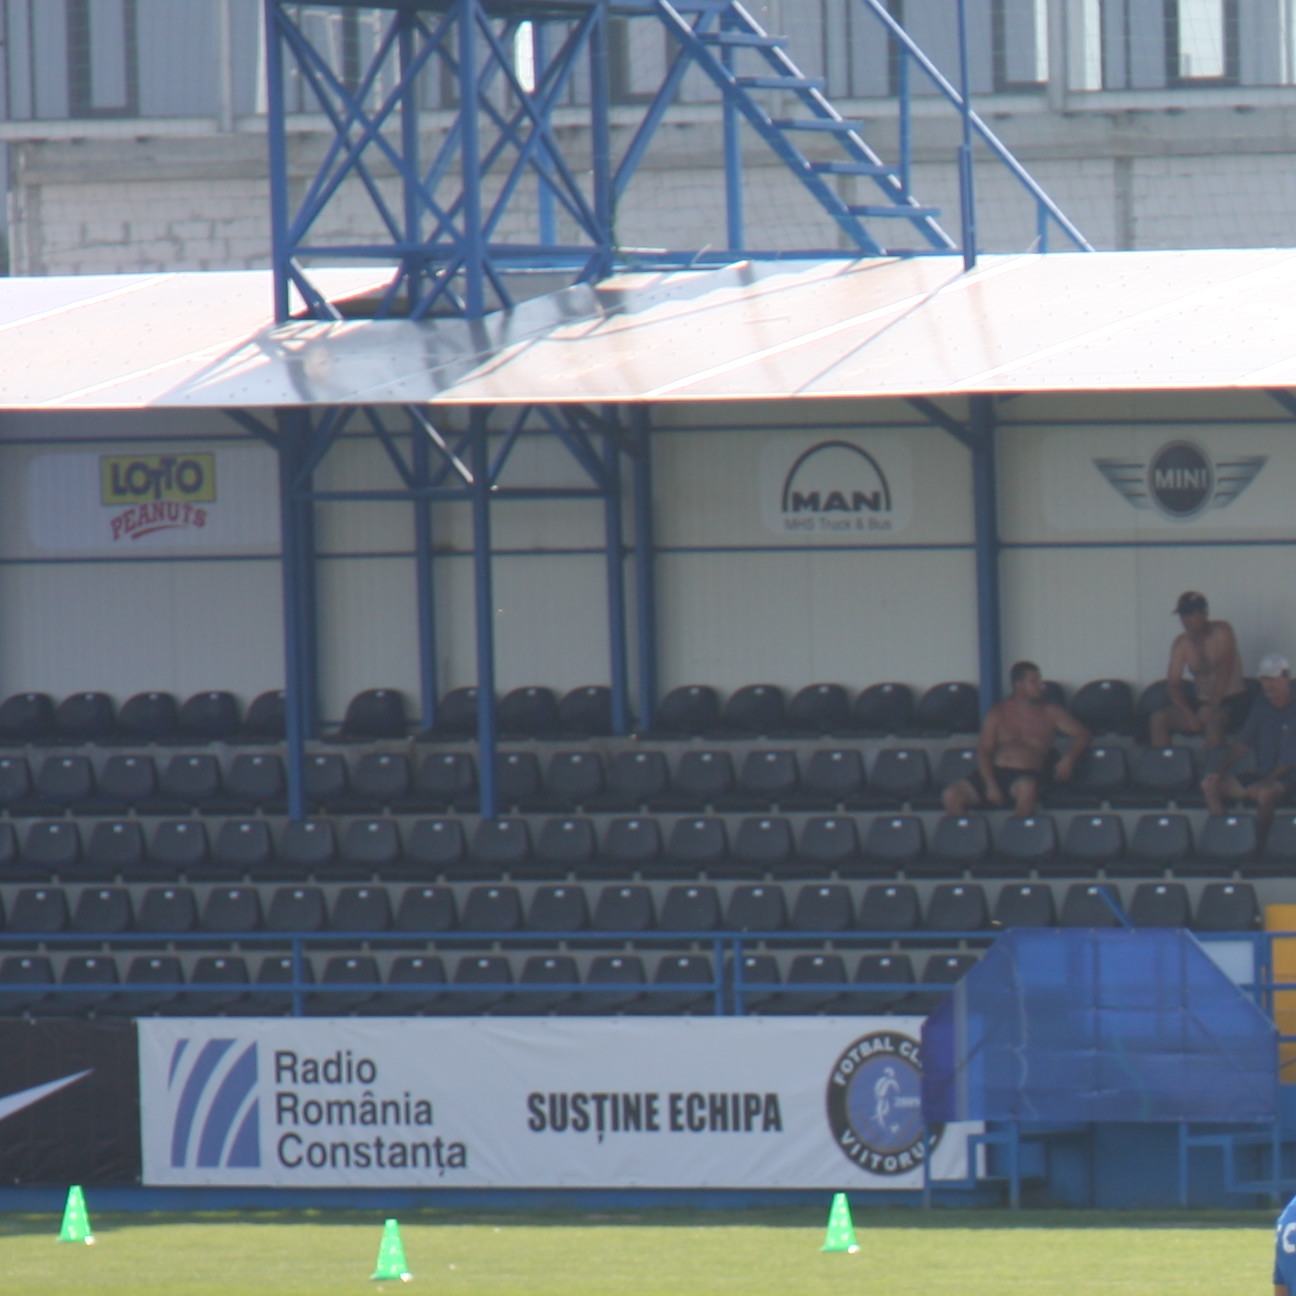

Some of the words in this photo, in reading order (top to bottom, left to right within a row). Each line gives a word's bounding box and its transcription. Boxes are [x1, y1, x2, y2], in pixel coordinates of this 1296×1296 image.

[111, 457, 204, 500] LOTTO
[1155, 468, 1207, 489] MINI
[110, 501, 207, 541] PEANUTS
[792, 490, 881, 512] MAN
[274, 1050, 377, 1084] Radio
[833, 1036, 894, 1086] FOTBAL
[275, 1090, 433, 1125] România
[527, 1092, 660, 1144] SUSȚINE
[668, 1092, 783, 1132] ECHIPA
[277, 1132, 467, 1176] Constanța
